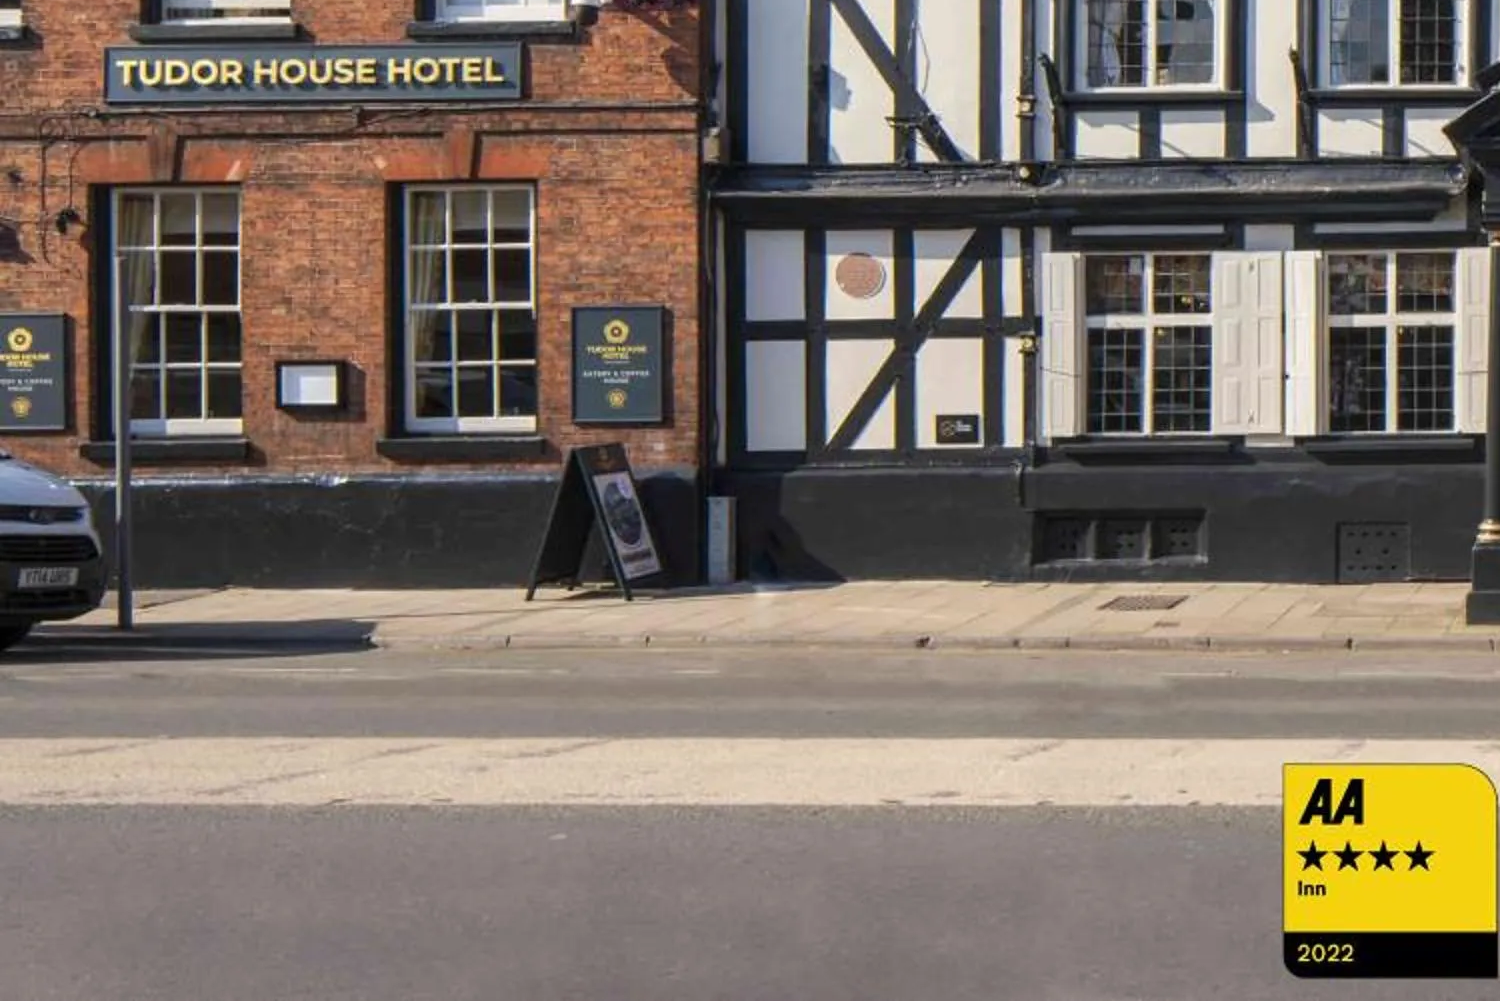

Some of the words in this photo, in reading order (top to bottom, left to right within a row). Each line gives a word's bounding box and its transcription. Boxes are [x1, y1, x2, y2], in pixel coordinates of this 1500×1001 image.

[116, 59, 243, 86] TUDOR
[253, 58, 377, 85] HOUSE
[387, 57, 504, 83] HOTEL
